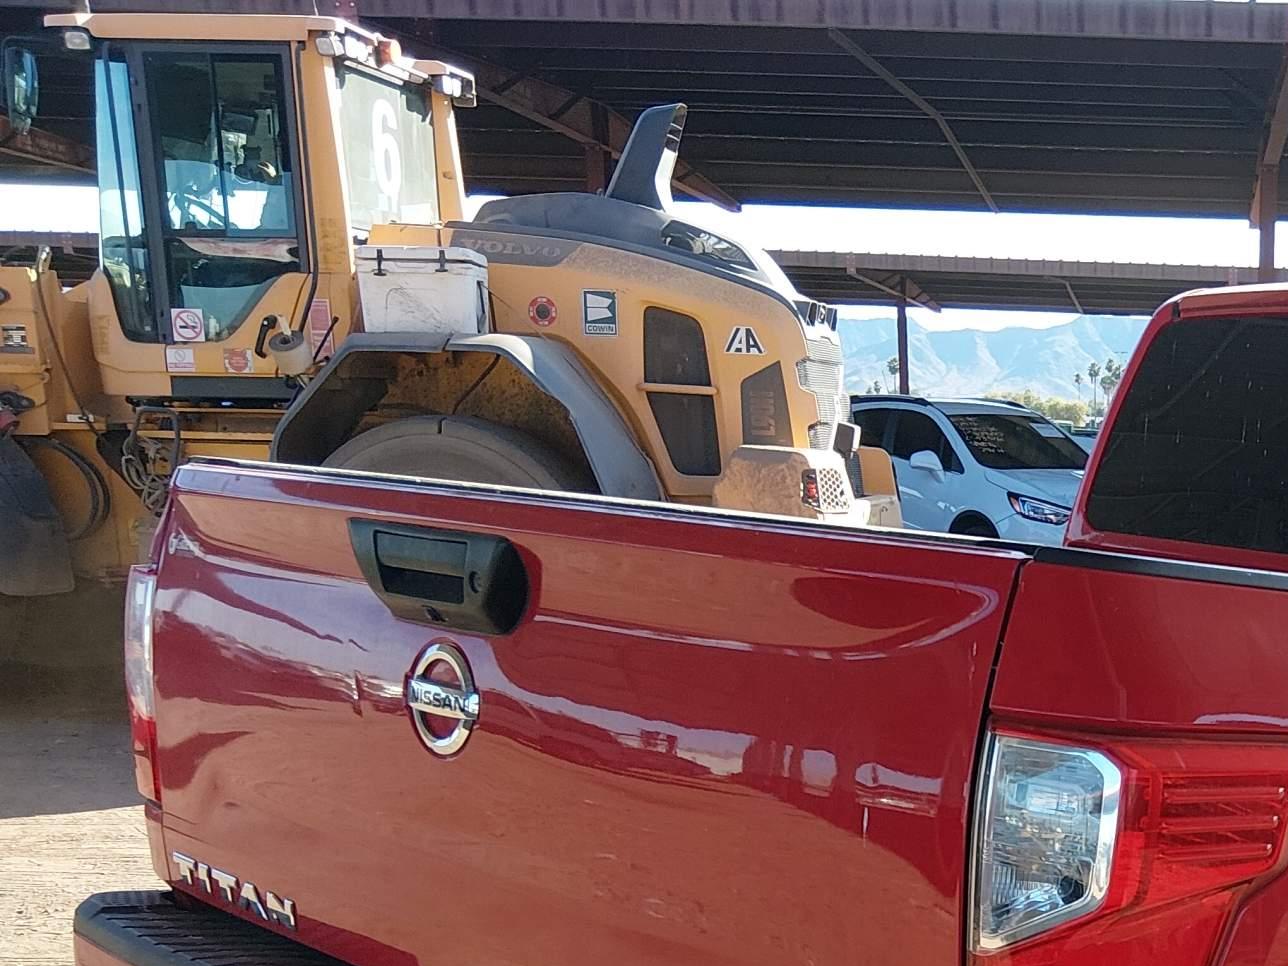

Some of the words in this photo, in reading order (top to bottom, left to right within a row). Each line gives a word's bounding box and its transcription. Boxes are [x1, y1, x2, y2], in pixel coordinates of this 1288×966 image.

[372, 98, 401, 198] 6
[460, 238, 561, 257] VOLVO
[587, 324, 614, 333] COWIN
[410, 685, 467, 712] NISSAN
[172, 850, 297, 928] TITAN
